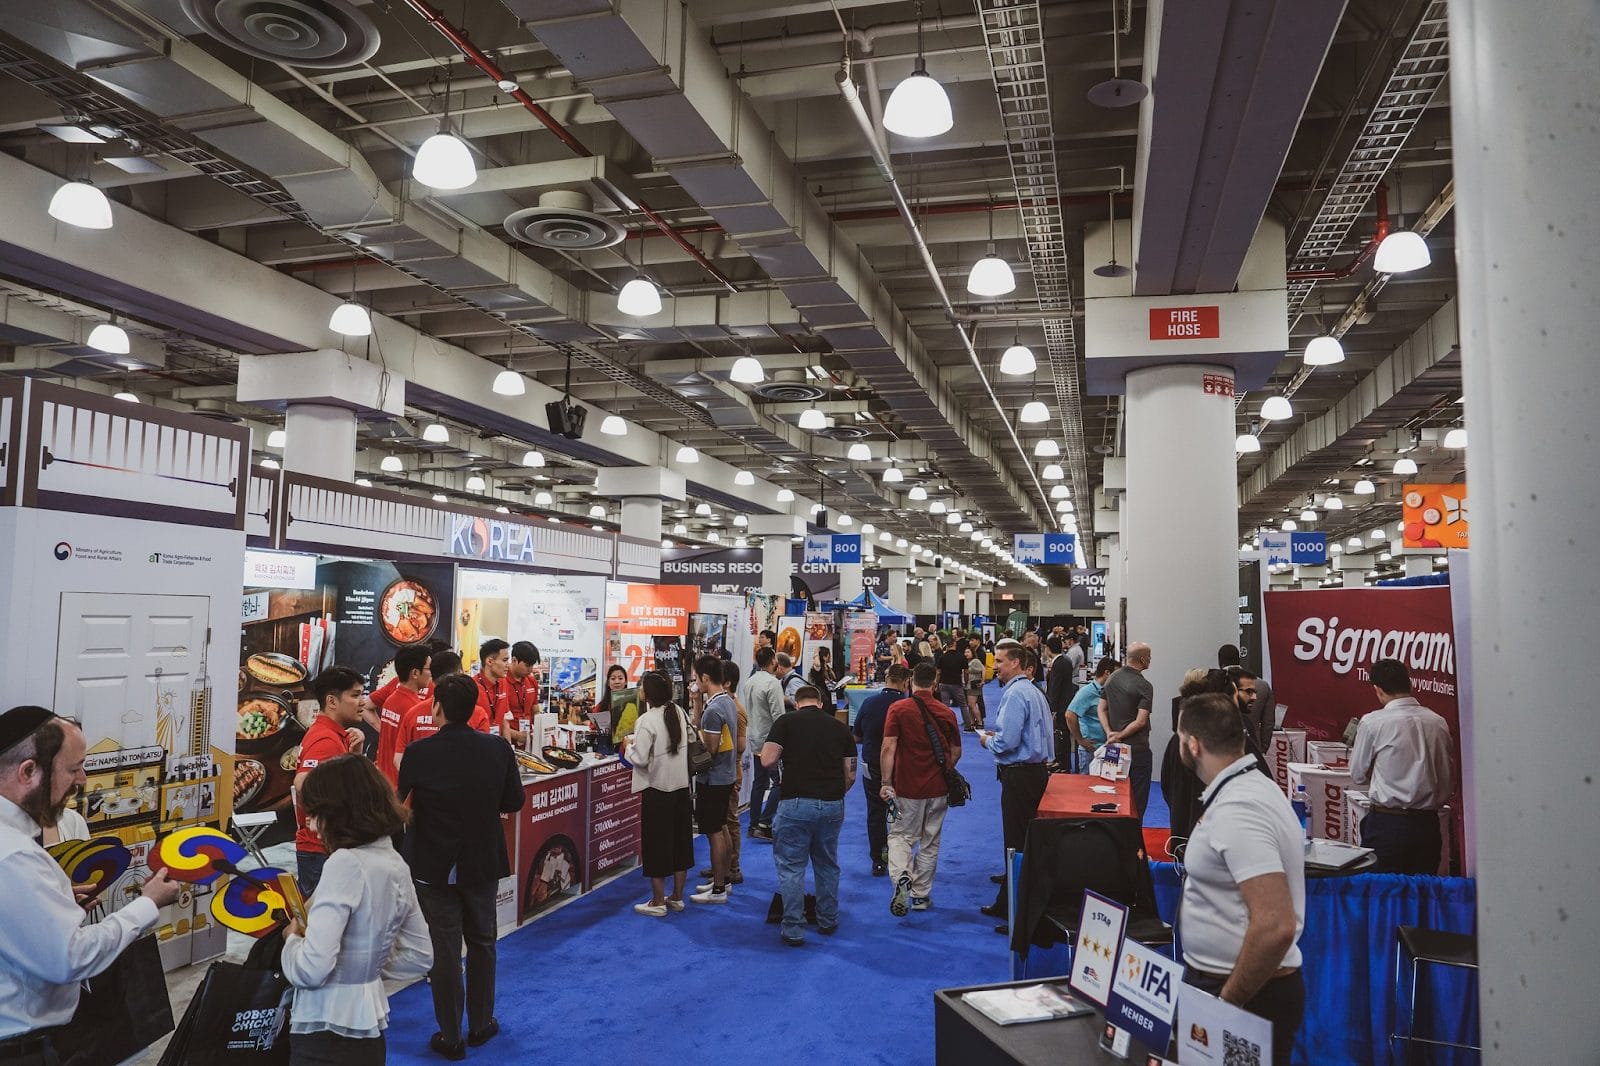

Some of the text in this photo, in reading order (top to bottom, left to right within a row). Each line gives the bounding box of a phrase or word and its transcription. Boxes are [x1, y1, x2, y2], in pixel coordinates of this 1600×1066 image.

[1171, 310, 1198, 323] FIRE
[1168, 323, 1201, 336] HOSE
[450, 512, 536, 563] KOREA
[835, 543, 857, 552] 800
[1049, 543, 1073, 552] 900
[1292, 542, 1324, 552] 1000
[664, 562, 840, 574] BUSINESS RESOE CENT
[862, 576, 880, 586] OR
[1086, 586, 1106, 596] TH
[630, 606, 652, 616] LET'S
[1418, 678, 1432, 692] your
[1096, 912, 1112, 928] STAR
[1140, 960, 1170, 1004] IFA
[232, 1017, 273, 1032] CHICK
[1120, 1004, 1154, 1032] MEMBER
